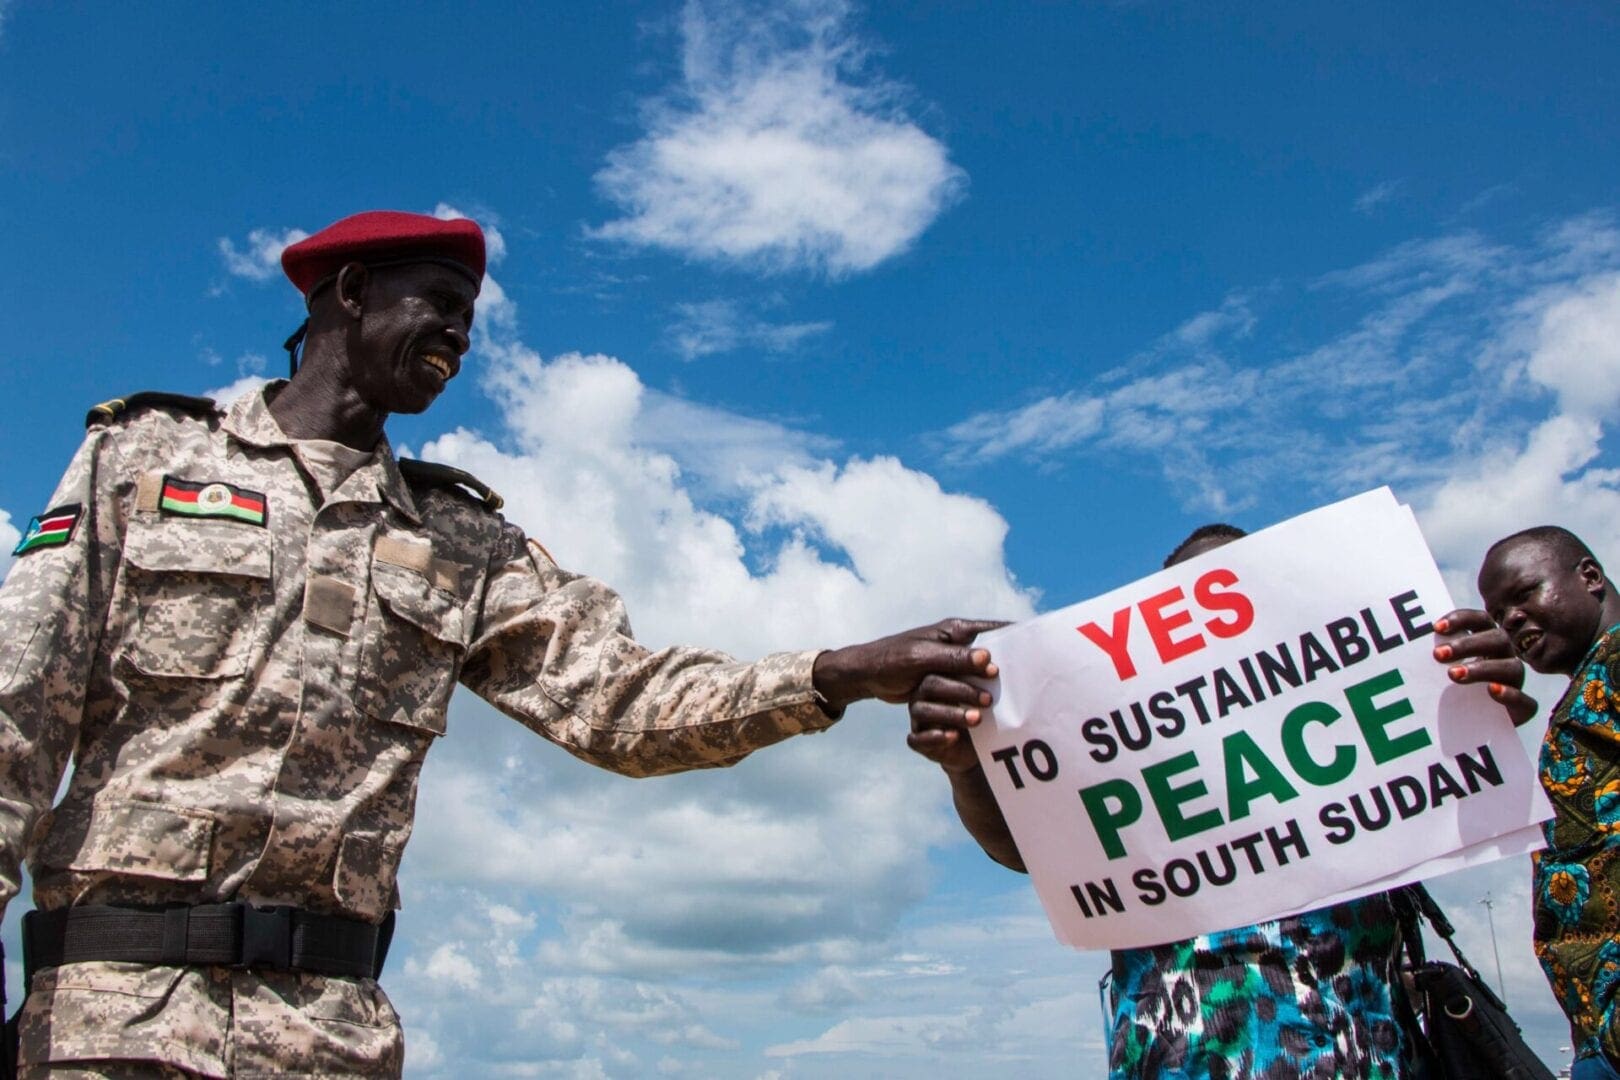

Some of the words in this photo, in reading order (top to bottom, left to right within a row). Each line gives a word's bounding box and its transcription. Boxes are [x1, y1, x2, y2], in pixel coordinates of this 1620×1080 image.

[991, 739, 1058, 789] TO
[1082, 589, 1434, 763] SUSTAINABLE
[1078, 569, 1254, 680] YES
[1070, 878, 1125, 918] IN
[1132, 818, 1311, 906] SOUTH
[1318, 745, 1504, 844] SUDAN
[1078, 668, 1432, 860] PEACE
